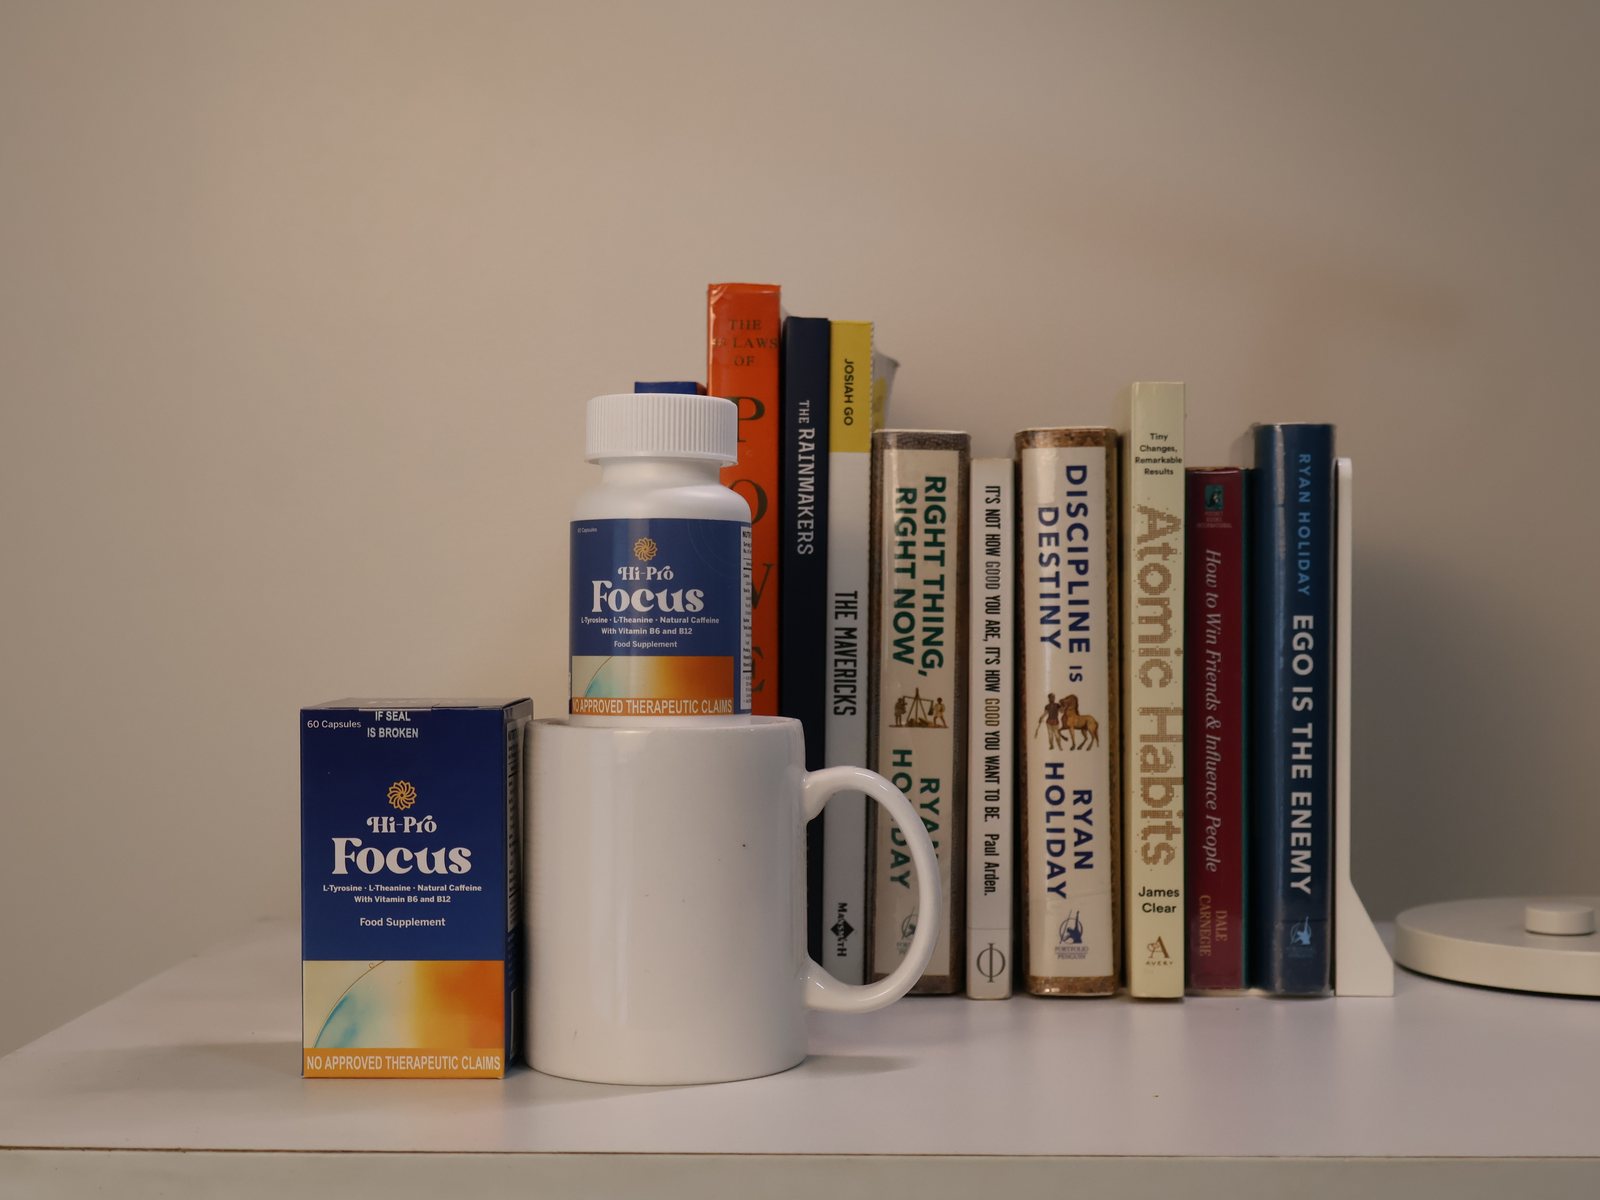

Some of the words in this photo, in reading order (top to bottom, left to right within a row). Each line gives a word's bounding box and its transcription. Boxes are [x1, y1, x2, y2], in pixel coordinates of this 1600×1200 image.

[729, 320, 761, 330] THE
[733, 338, 778, 348] LAWS
[734, 356, 754, 366] OF
[844, 358, 853, 403] JOSIAH
[798, 400, 810, 424] THE
[844, 406, 853, 426] GO
[1150, 432, 1168, 442] Tiny
[1139, 444, 1178, 454] Changes,
[1135, 456, 1182, 464] Remarkable
[1144, 468, 1174, 476] Results
[1298, 454, 1311, 503] RYAN
[797, 427, 816, 555] RAINMAKERS
[984, 486, 1000, 504] IT'S
[924, 476, 947, 567] RIGHT
[984, 509, 1000, 528] NOT
[894, 487, 917, 578] RIGHT
[984, 534, 1000, 555] HOW
[1298, 512, 1311, 596] HOLIDAY
[1065, 465, 1090, 654] DISCIPLINE
[1204, 549, 1221, 588] How
[618, 565, 674, 581] Hi-Pro
[984, 561, 1000, 589] GOOD
[1038, 507, 1063, 650] DESTINY
[592, 580, 704, 614] Focus
[834, 591, 858, 620] THE
[984, 595, 1000, 615] YOU
[1137, 504, 1182, 689] Atomic
[1204, 593, 1221, 608] to
[613, 616, 654, 624] L-Theanine
[660, 616, 689, 624] Natural
[691, 616, 720, 624] Caffeine
[892, 589, 916, 664] NOW
[918, 575, 945, 676] THING,
[983, 620, 1001, 641] ARE,
[1204, 613, 1221, 645] Win
[601, 627, 616, 635] With
[618, 627, 647, 635] Vitamin
[649, 627, 660, 635] B6
[662, 627, 677, 635] and
[679, 627, 693, 635] B12
[614, 640, 631, 648] Food
[632, 640, 678, 649] Supplement
[984, 646, 1000, 664] IT'S
[1292, 615, 1314, 676] EGO
[832, 626, 857, 716] MAVERICKS
[984, 669, 1000, 691] HOW
[1069, 666, 1082, 682] IS
[1204, 649, 1221, 710] Friends
[580, 699, 623, 713] APPROVED
[626, 699, 699, 713] THERAPEUTIC
[701, 699, 732, 713] CLAIMS
[1291, 686, 1313, 711] IS
[375, 711, 383, 721] IF
[386, 711, 411, 722] SEAL
[984, 698, 1000, 726] GOOD
[1204, 716, 1221, 728] &
[307, 720, 319, 729] 60
[321, 720, 362, 731] Capsules
[367, 728, 376, 738] IS
[378, 728, 419, 738] BROKEN
[984, 731, 1000, 750] YOU
[1291, 723, 1313, 780] THE
[984, 756, 1000, 783] WANT
[1204, 734, 1221, 809] Influence
[984, 789, 1000, 801] TO
[1138, 707, 1184, 866] Habits
[366, 815, 437, 834] Hi-Pro
[891, 749, 912, 888] HODAY
[984, 806, 1000, 822] BE.
[1044, 763, 1066, 899] HOLIDAY
[1073, 790, 1093, 869] RYAN
[984, 834, 1000, 855] Paul
[1204, 815, 1221, 872] People
[1291, 793, 1313, 895] ENEMY
[332, 837, 471, 875] Focus
[323, 884, 362, 893] L-Tyrosine
[369, 884, 411, 893] L-Theanine
[417, 884, 447, 893] Natural
[449, 884, 482, 893] Caffeine
[984, 862, 1000, 895] Arden.
[354, 895, 373, 903] With
[374, 895, 405, 903] Vitamin
[407, 895, 418, 903] B6
[420, 895, 435, 903] and
[436, 895, 451, 903] B12
[1138, 887, 1180, 899] James
[1142, 902, 1177, 913] Clear
[360, 917, 384, 927] Food
[386, 917, 446, 929] Supplement
[1198, 895, 1211, 956] CARNEGIE
[1215, 910, 1228, 941] DALE
[307, 1056, 322, 1070] NO
[324, 1056, 383, 1070] APPROVED
[385, 1056, 459, 1070] THERAPEUTIC
[461, 1056, 500, 1070] CLAIMS
